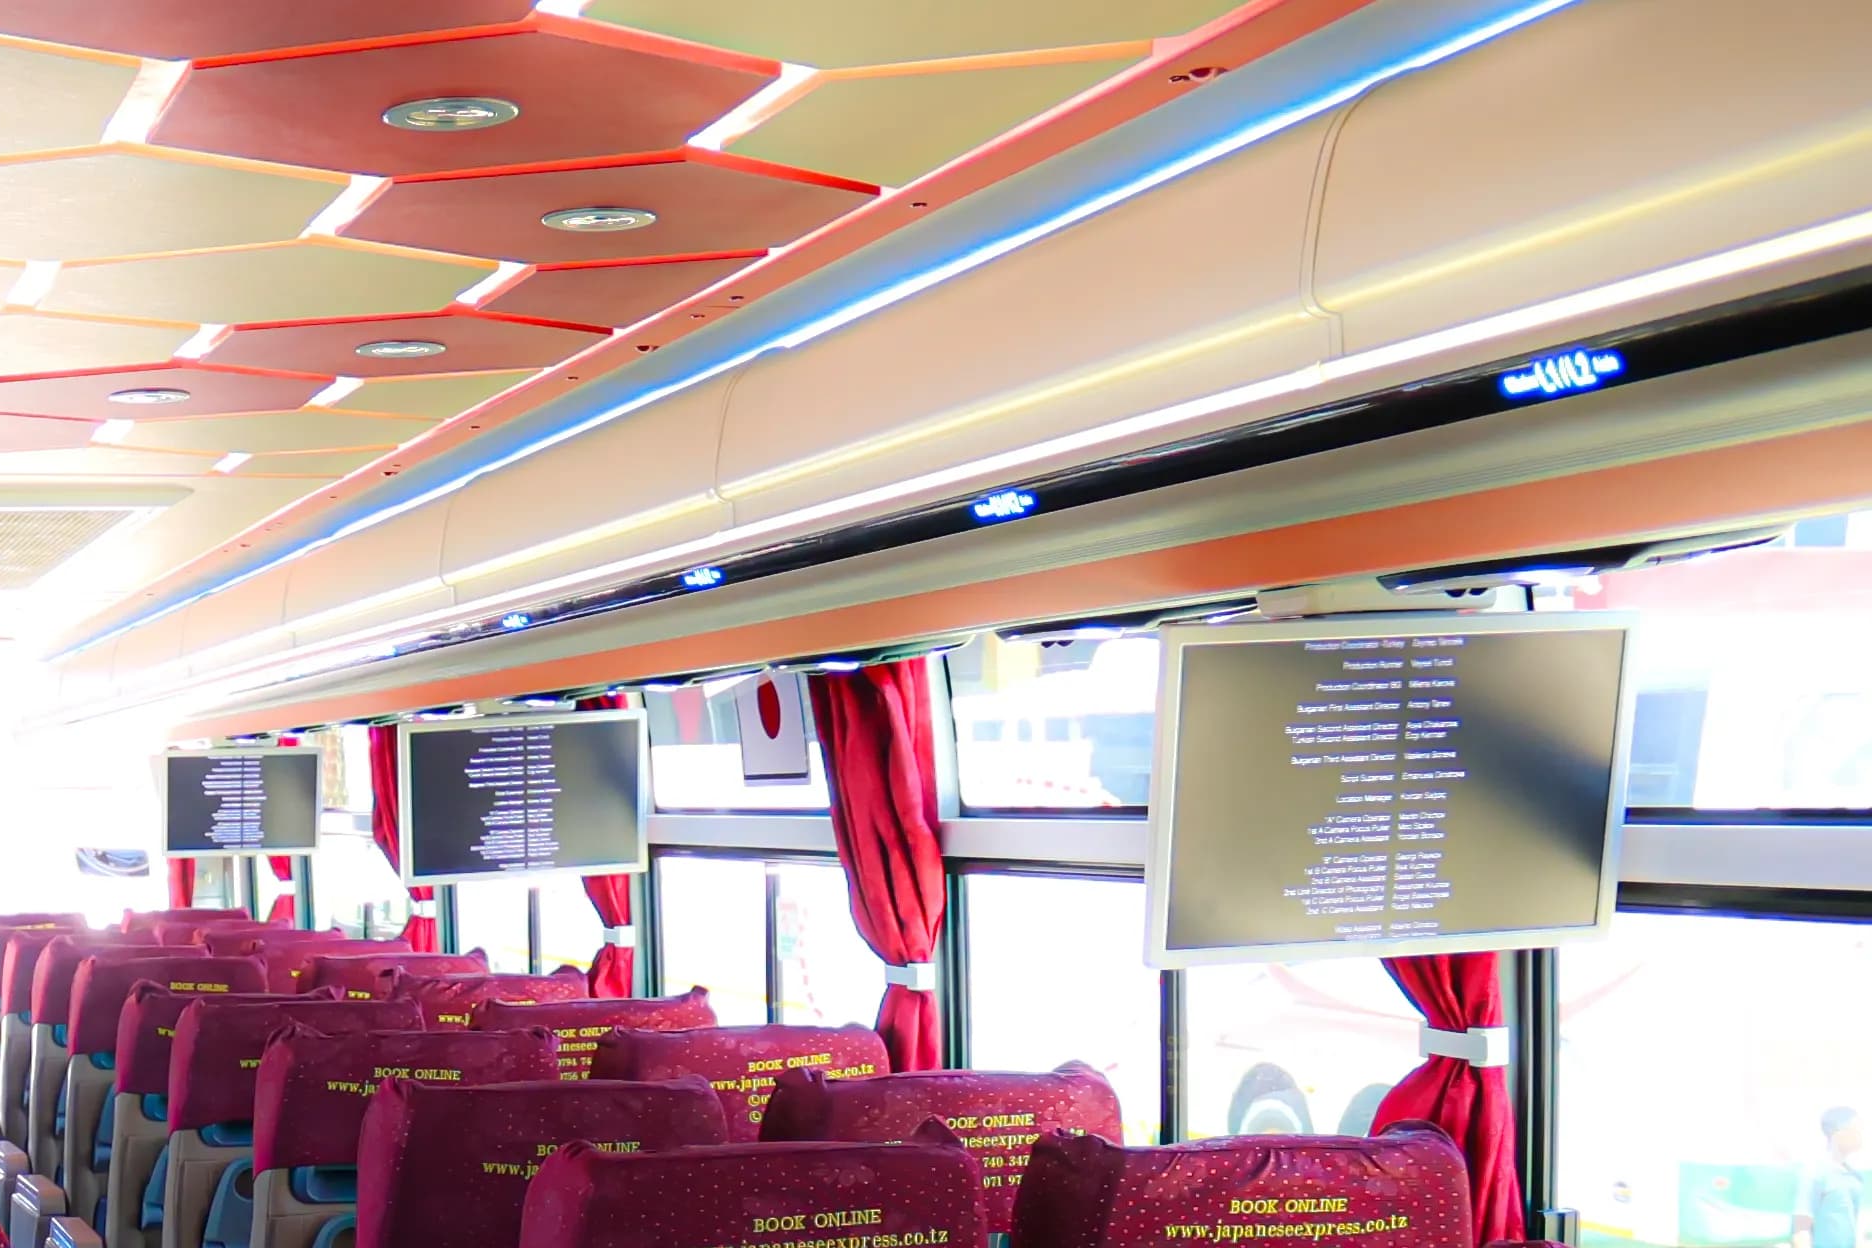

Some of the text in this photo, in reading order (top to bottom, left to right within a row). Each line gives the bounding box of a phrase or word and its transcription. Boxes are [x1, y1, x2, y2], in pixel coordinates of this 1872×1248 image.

[748, 1054, 831, 1073] BOOK ONLINE
[415, 1069, 461, 1080] ONLINE
[946, 1114, 1034, 1129] OOK ONLINE
[982, 1155, 1030, 1168] 740 347
[1008, 1175, 1023, 1186] 97
[1228, 1198, 1348, 1214] BOOK ONLINE
[753, 1209, 882, 1233] BOOK ONLINE
[1164, 1214, 1409, 1244] www.japaneseexpress.co.tz
